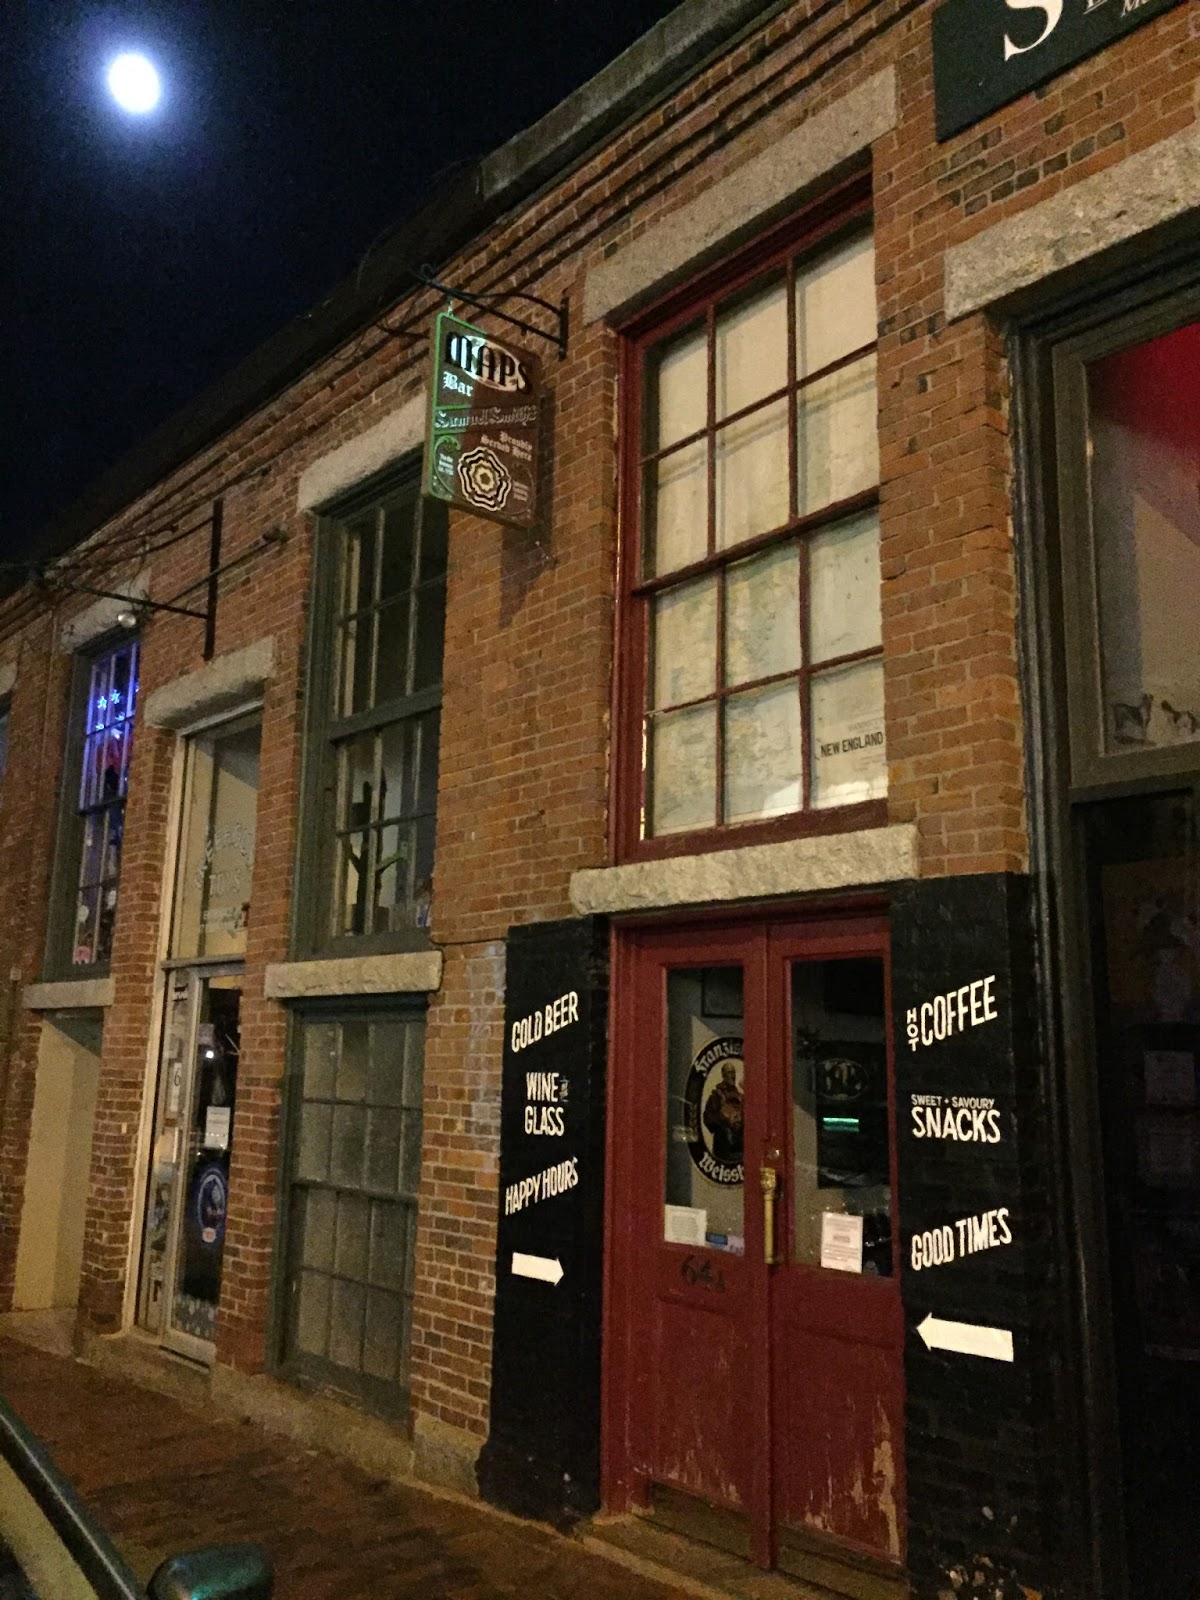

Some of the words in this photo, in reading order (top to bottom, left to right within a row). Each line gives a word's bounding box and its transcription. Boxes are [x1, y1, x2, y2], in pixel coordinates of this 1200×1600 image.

[444, 330, 534, 395] MAPS
[442, 371, 474, 398] Bar
[820, 741, 840, 757] NEW
[841, 731, 883, 752] ENGLAND
[511, 1010, 543, 1053] COLD
[544, 990, 579, 1035] BEER
[906, 1007, 919, 1052] HOT
[920, 975, 998, 1046] COFFEE
[526, 1072, 560, 1102] WINE
[911, 1094, 942, 1106] SWEET
[951, 1096, 995, 1110] SAVOURY
[524, 1105, 565, 1137] GLASS
[911, 1106, 1001, 1144] SNACKS
[505, 1173, 542, 1216] HAPPY
[541, 1156, 579, 1200] HOURS
[911, 1225, 955, 1272] GOOD
[955, 1207, 1013, 1258] TIMES
